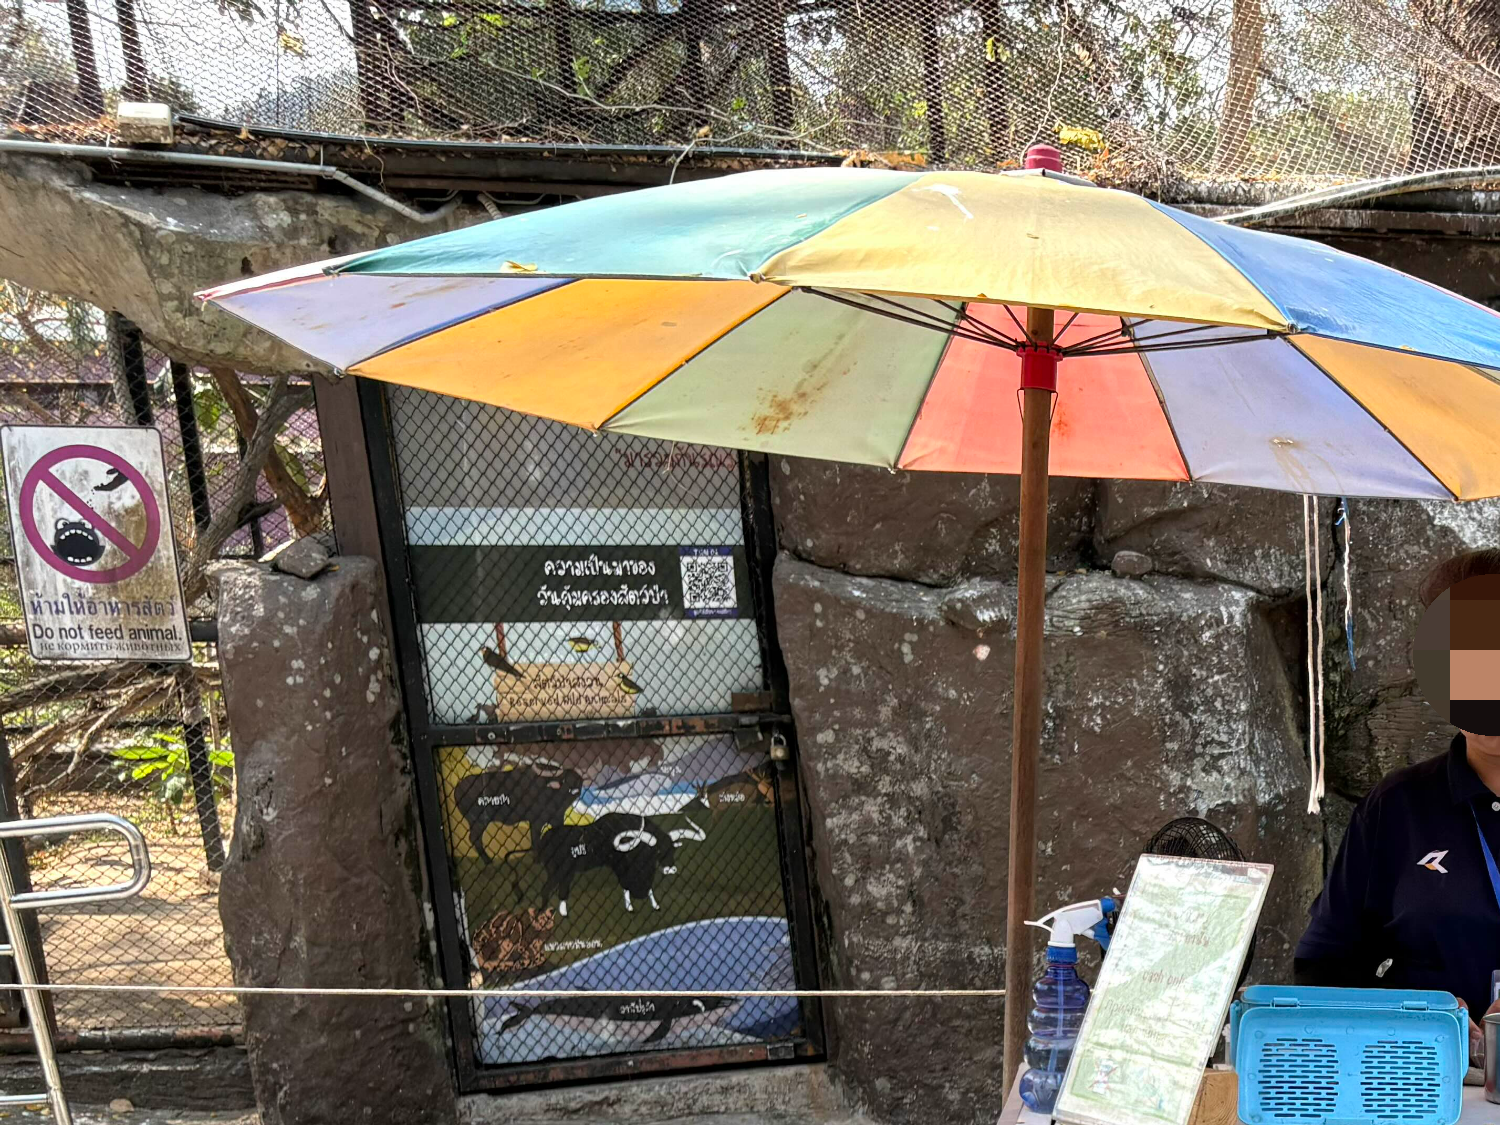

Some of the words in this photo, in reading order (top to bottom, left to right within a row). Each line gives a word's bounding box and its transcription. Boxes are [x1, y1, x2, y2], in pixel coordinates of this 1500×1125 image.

[32, 624, 54, 640] Do
[59, 624, 83, 639] not
[89, 624, 123, 640] feed
[129, 624, 182, 641] animal.
